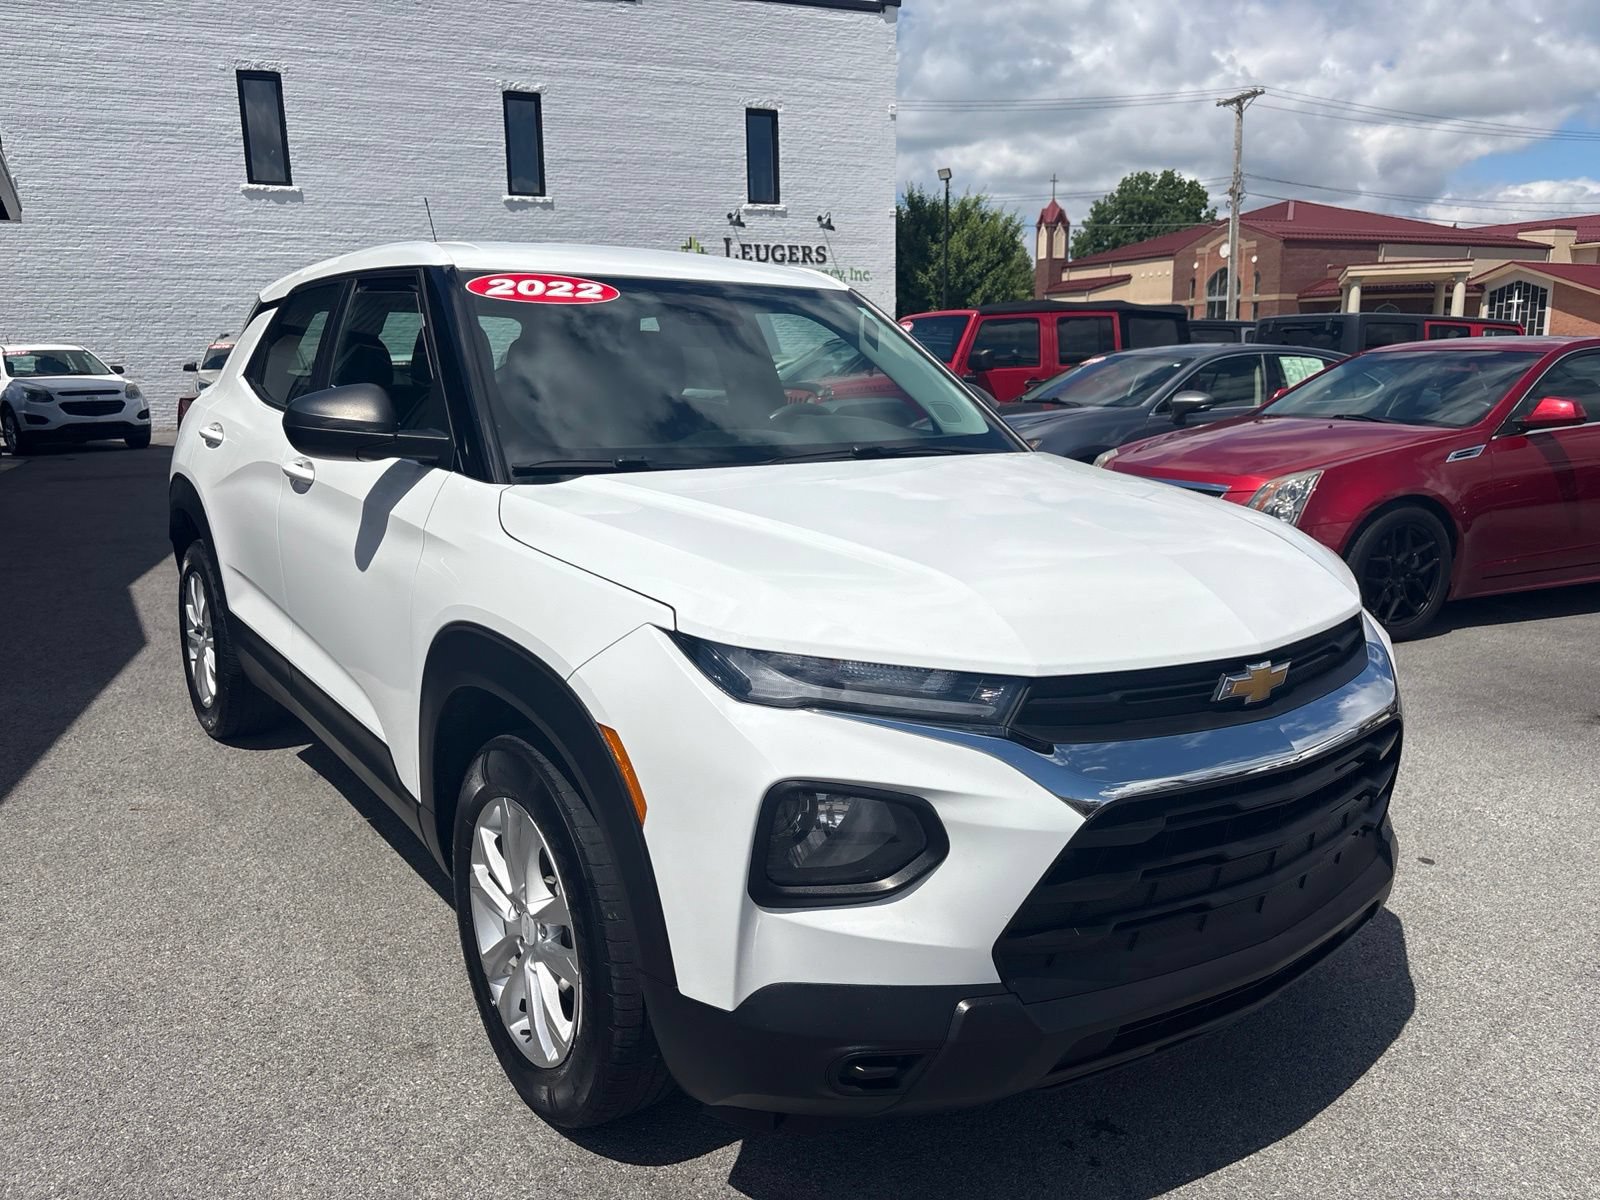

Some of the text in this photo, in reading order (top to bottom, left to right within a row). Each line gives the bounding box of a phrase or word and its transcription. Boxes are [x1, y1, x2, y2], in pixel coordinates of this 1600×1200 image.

[723, 237, 827, 263] LEUGERS
[849, 267, 873, 282] Inc.
[485, 278, 604, 299] 2022
